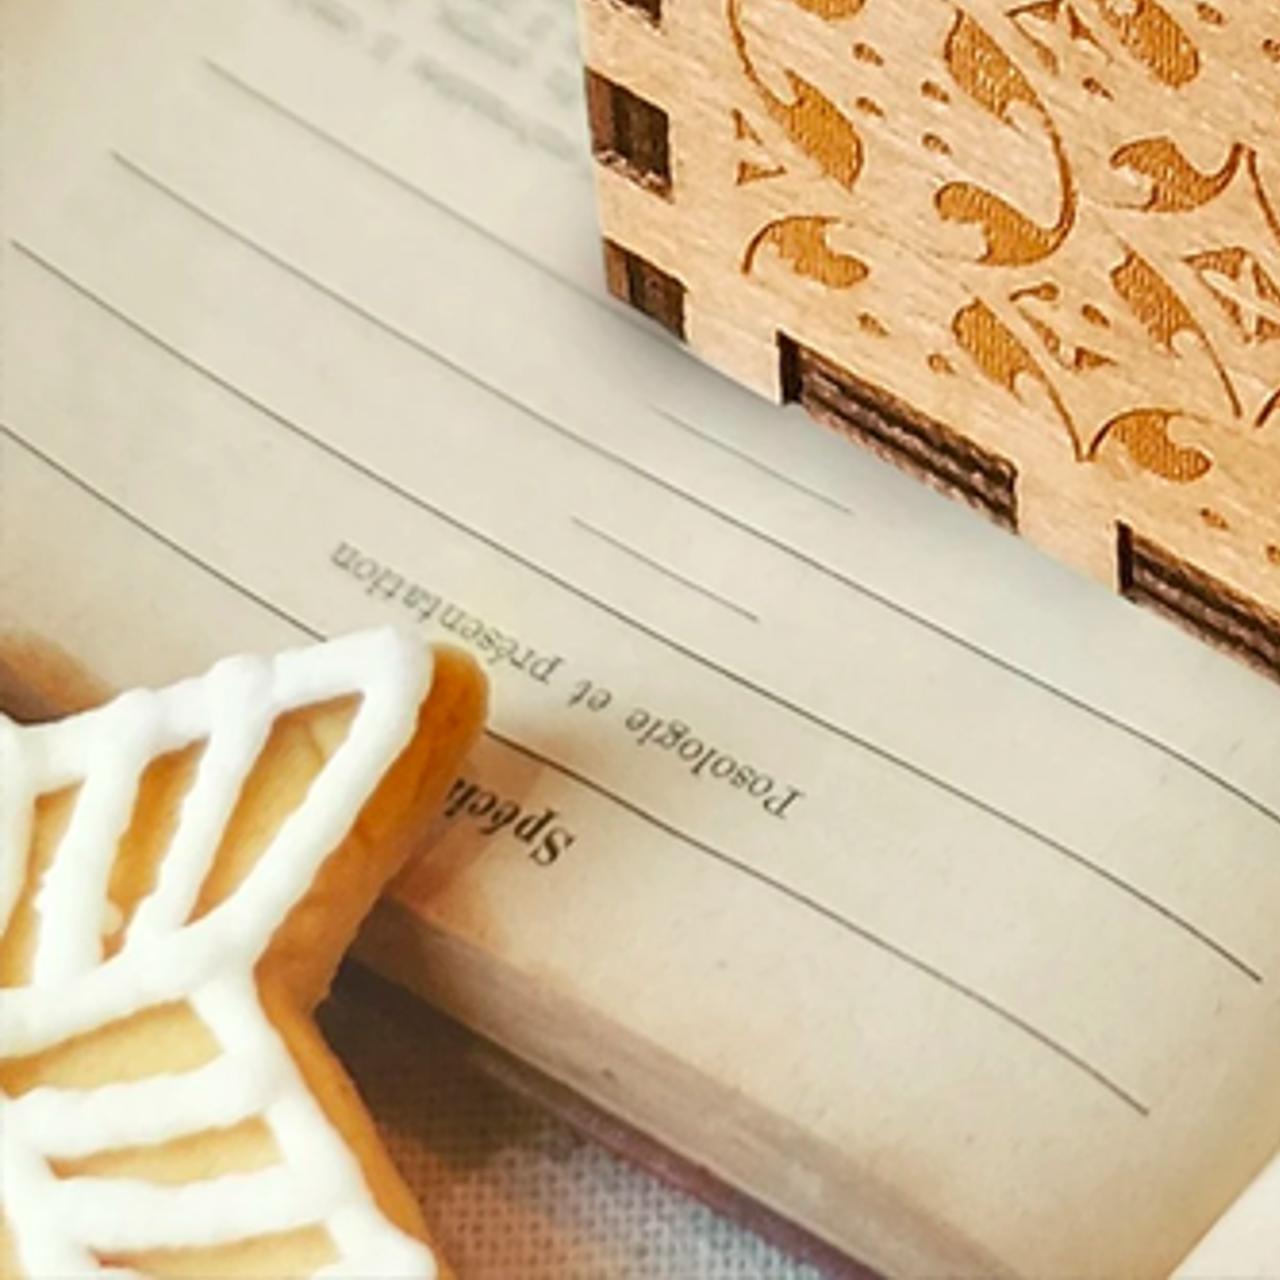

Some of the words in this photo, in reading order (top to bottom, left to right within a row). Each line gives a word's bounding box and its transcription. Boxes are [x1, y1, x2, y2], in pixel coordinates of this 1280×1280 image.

[330, 540, 564, 684] présentation
[573, 677, 613, 712] et
[625, 706, 806, 819] Posologie
